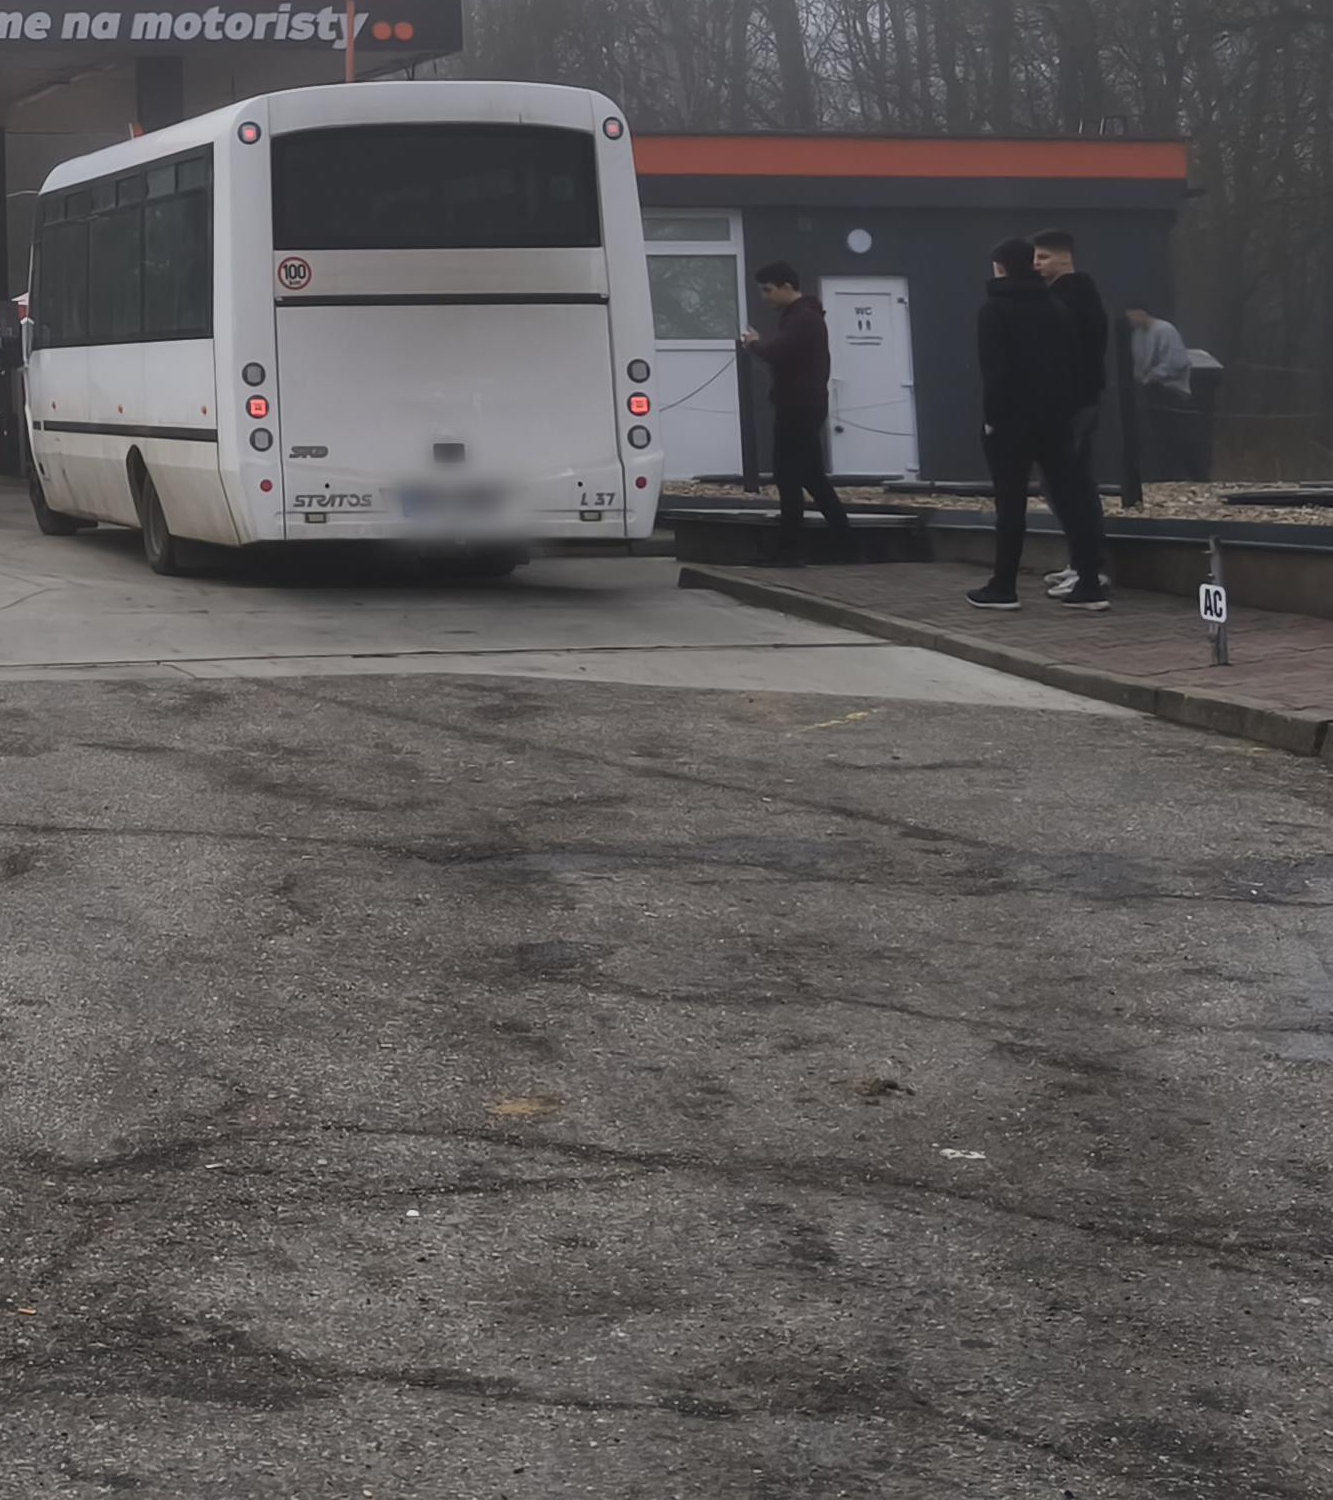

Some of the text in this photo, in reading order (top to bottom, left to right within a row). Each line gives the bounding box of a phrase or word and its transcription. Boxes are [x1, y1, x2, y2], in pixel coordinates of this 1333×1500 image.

[60, 12, 118, 41] na
[130, 4, 370, 50] motoristy
[283, 264, 306, 280] 100
[293, 493, 372, 508] STRATOS
[580, 492, 615, 506] L 37
[1204, 588, 1223, 618] AC
